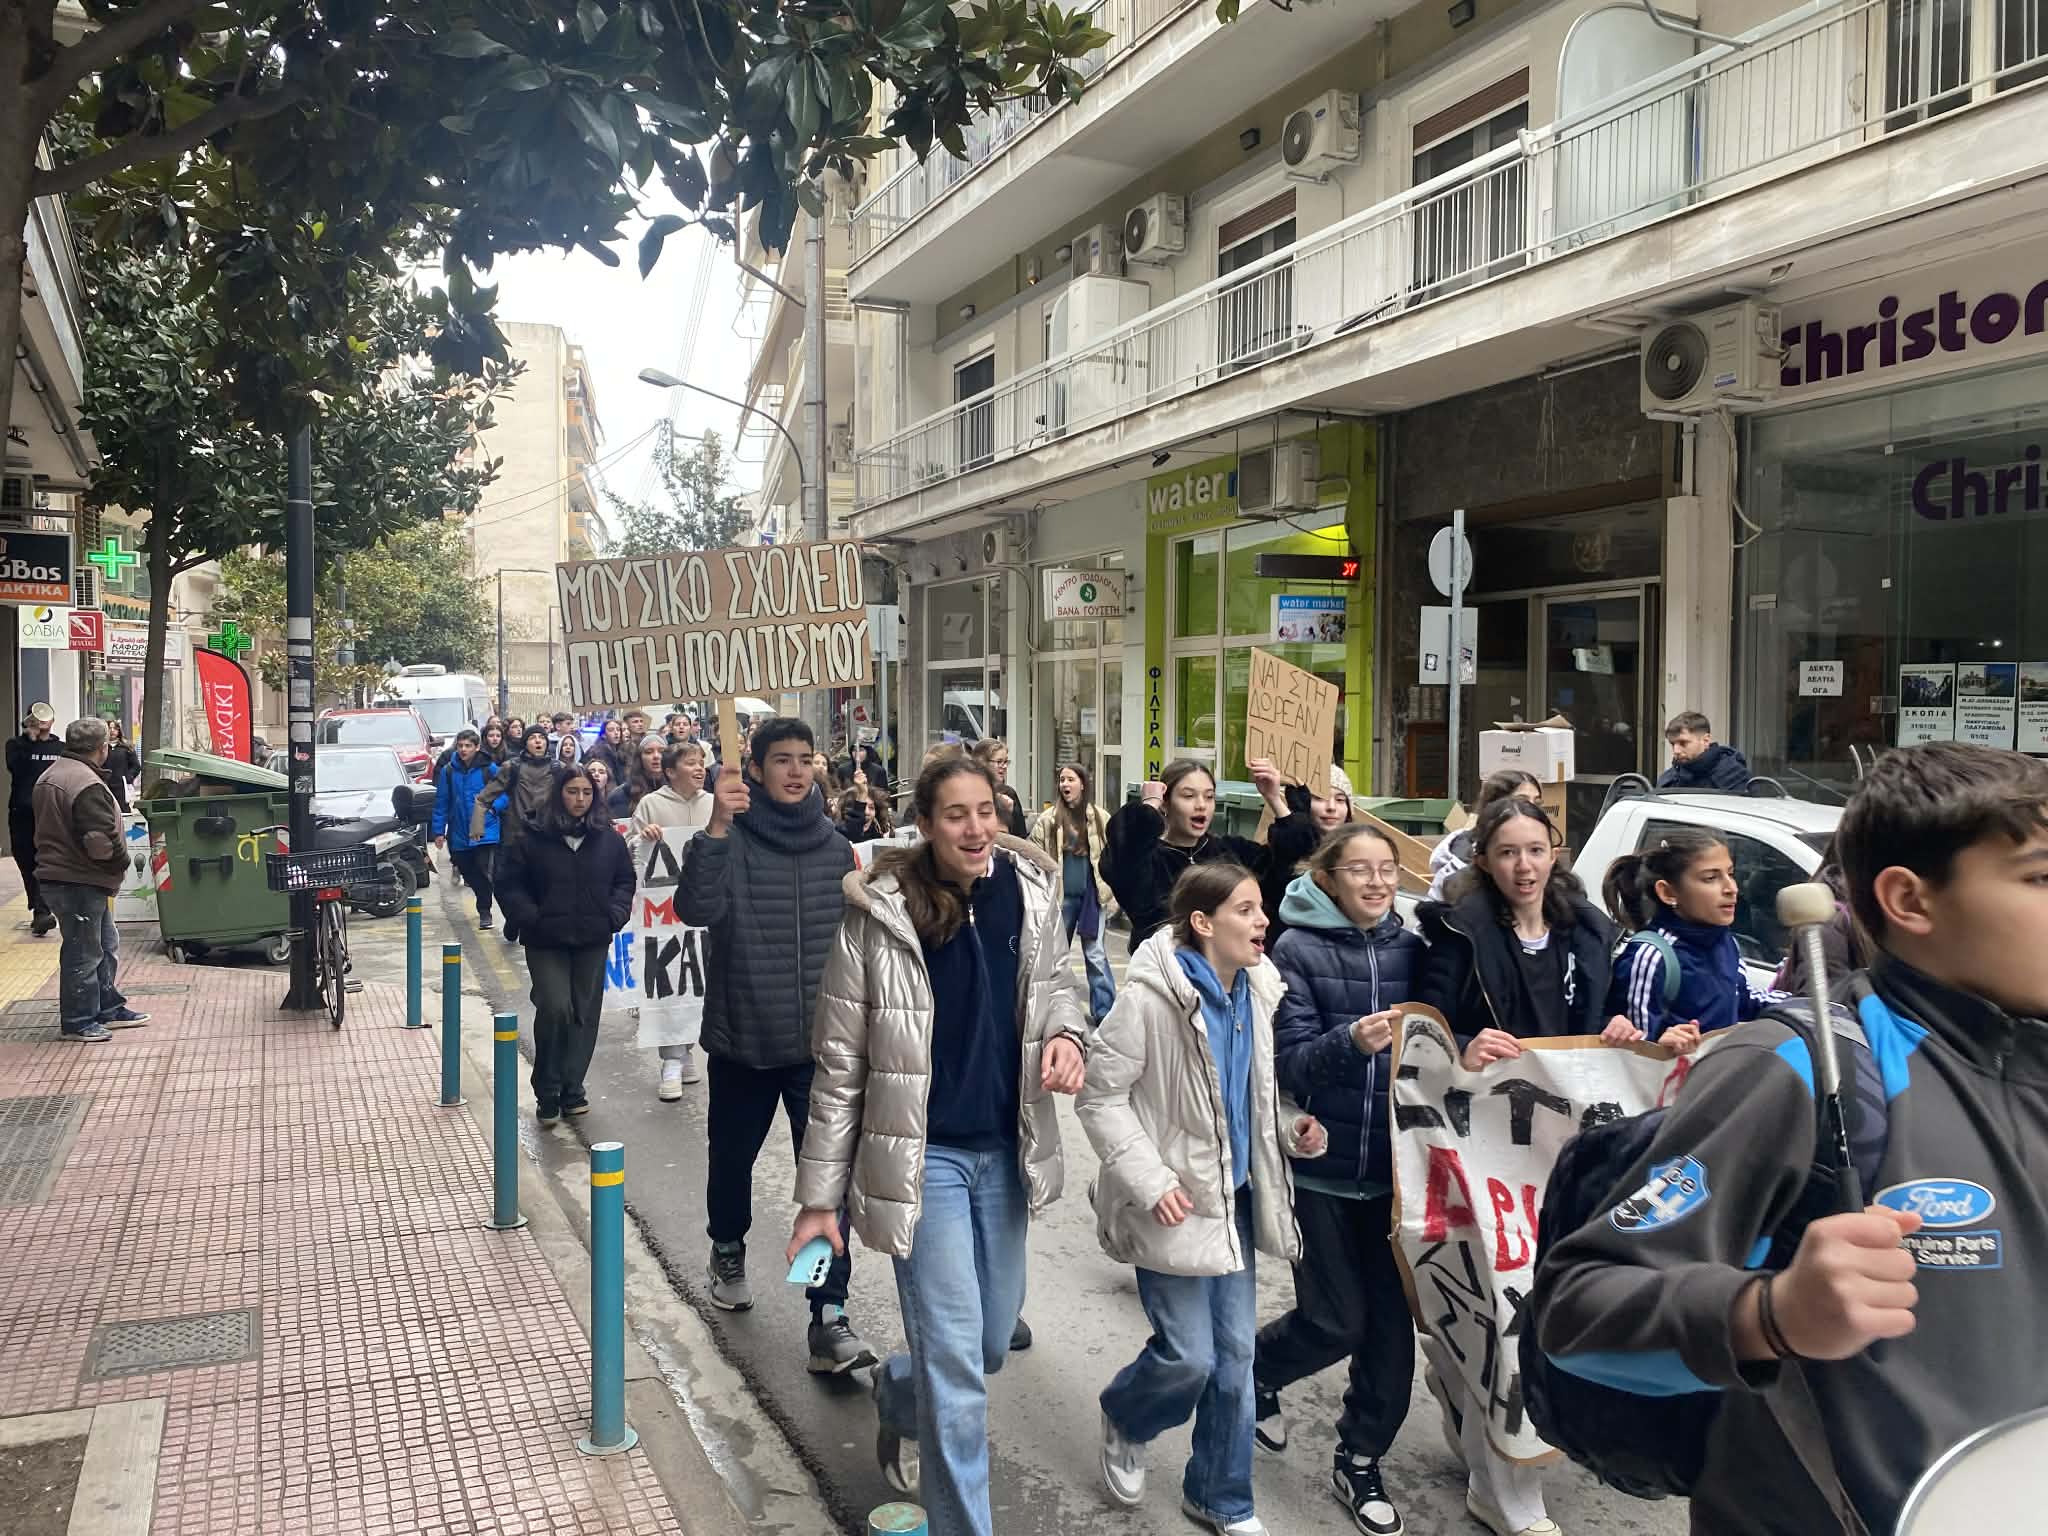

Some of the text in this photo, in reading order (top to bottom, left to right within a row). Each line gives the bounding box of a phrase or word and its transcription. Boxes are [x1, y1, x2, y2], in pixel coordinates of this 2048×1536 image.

[1150, 472, 1224, 514] water
[1912, 444, 2048, 520] Chri
[0, 583, 63, 597] ΑΚΤΙΚΑ
[557, 542, 864, 633] ΜΟΥΣΙΚΟ ΣΧΟΛΕΙΟ
[1057, 605, 1080, 616] ΒΑΝΑ
[1281, 599, 1345, 608] water market
[568, 618, 870, 707] ΠΗΓΗ ΠΟΛΙΤΙΣΜΟΥ
[1253, 654, 1327, 709] ΝΑΙ ΣΤΗ
[1149, 667, 1161, 748] ΦΙΛΤΡΑ
[1149, 761, 1160, 782] ΝΕ
[1901, 1187, 1973, 1217] Ford
[1900, 1236, 1997, 1251] nuine Parts
[1918, 1250, 1981, 1265] Service
